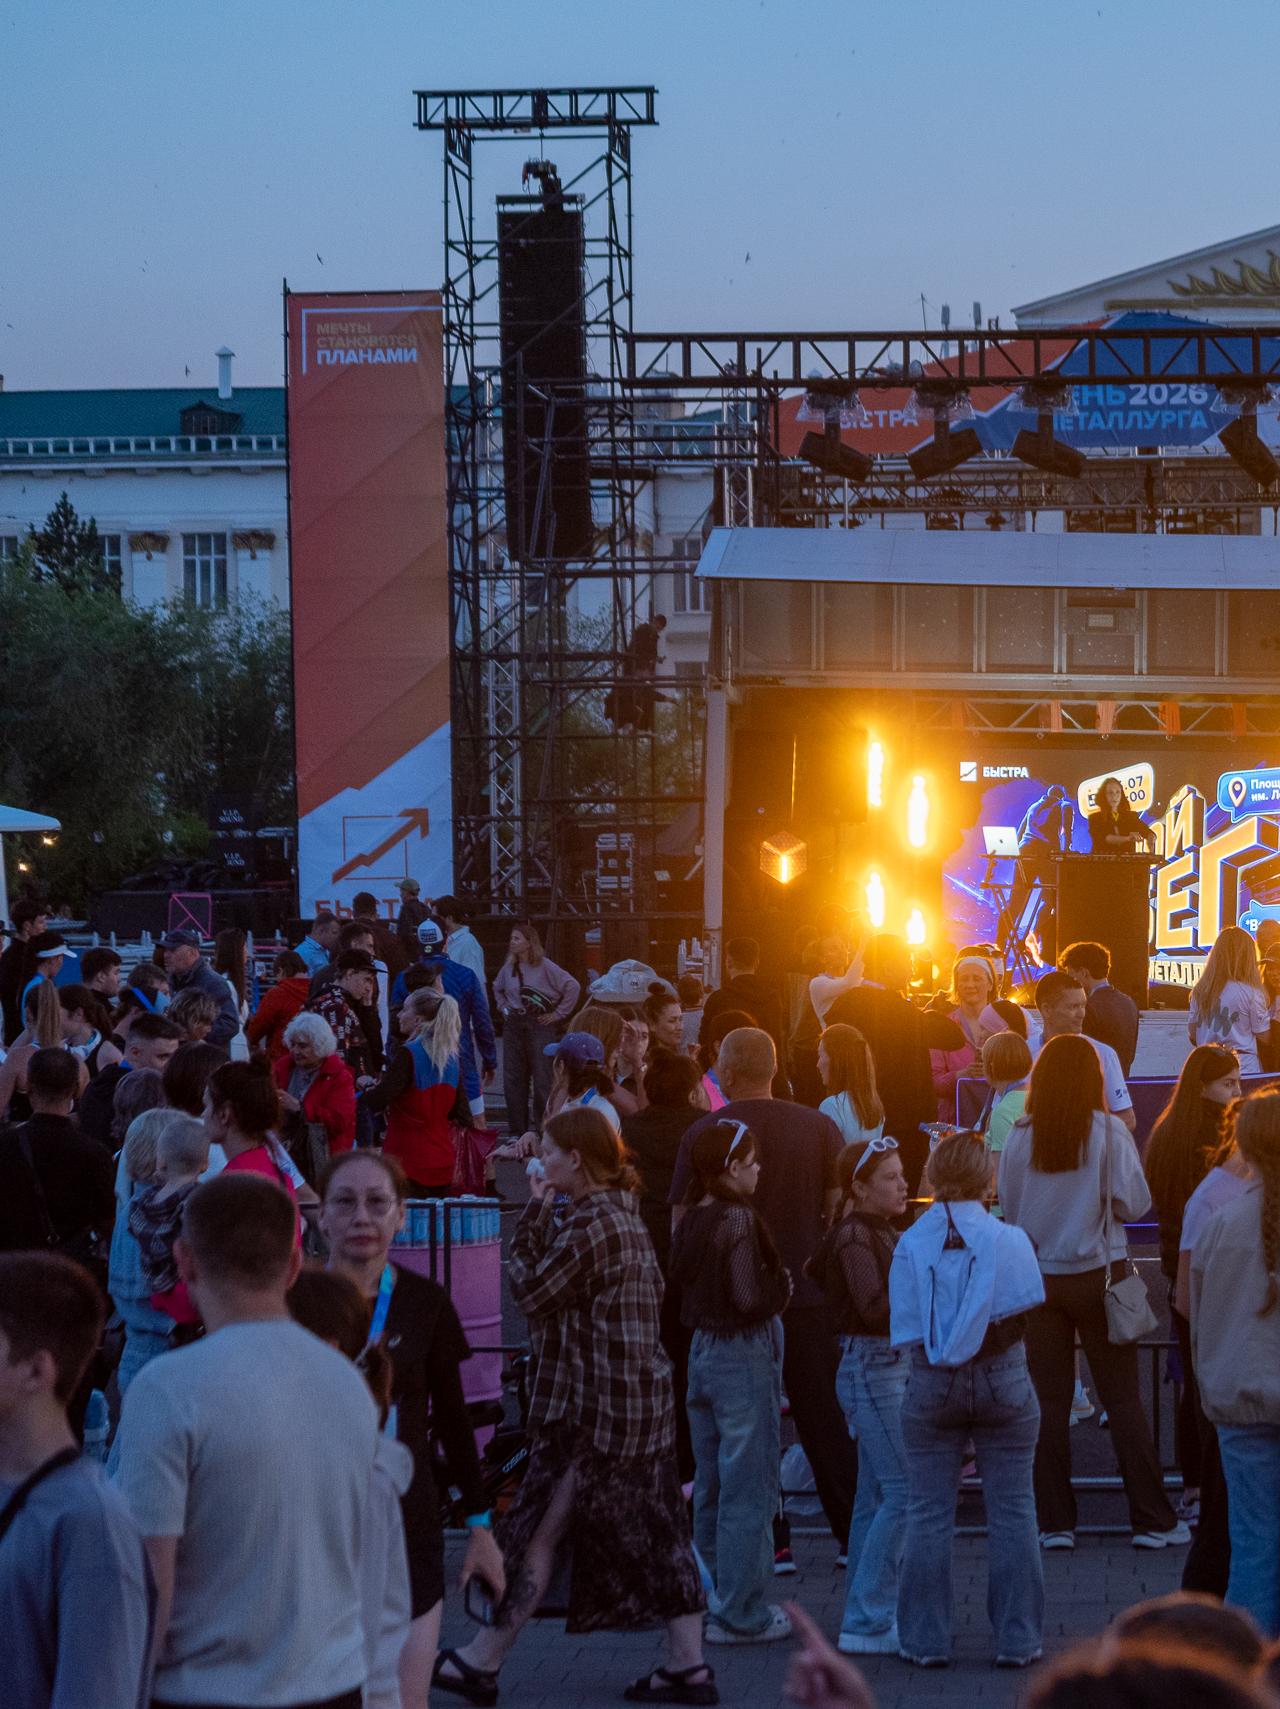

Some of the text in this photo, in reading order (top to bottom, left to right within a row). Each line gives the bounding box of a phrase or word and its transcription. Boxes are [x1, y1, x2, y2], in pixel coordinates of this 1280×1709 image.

[316, 322, 371, 334] МЕЧТЫ
[316, 347, 418, 365] ПЛАНАМИ
[1072, 384, 1208, 407] ЕНЬ 2026
[1053, 409, 1209, 432] ЕТАЛЛУРГА
[982, 766, 1030, 778] БЫСТРА
[1251, 792, 1269, 802] им.
